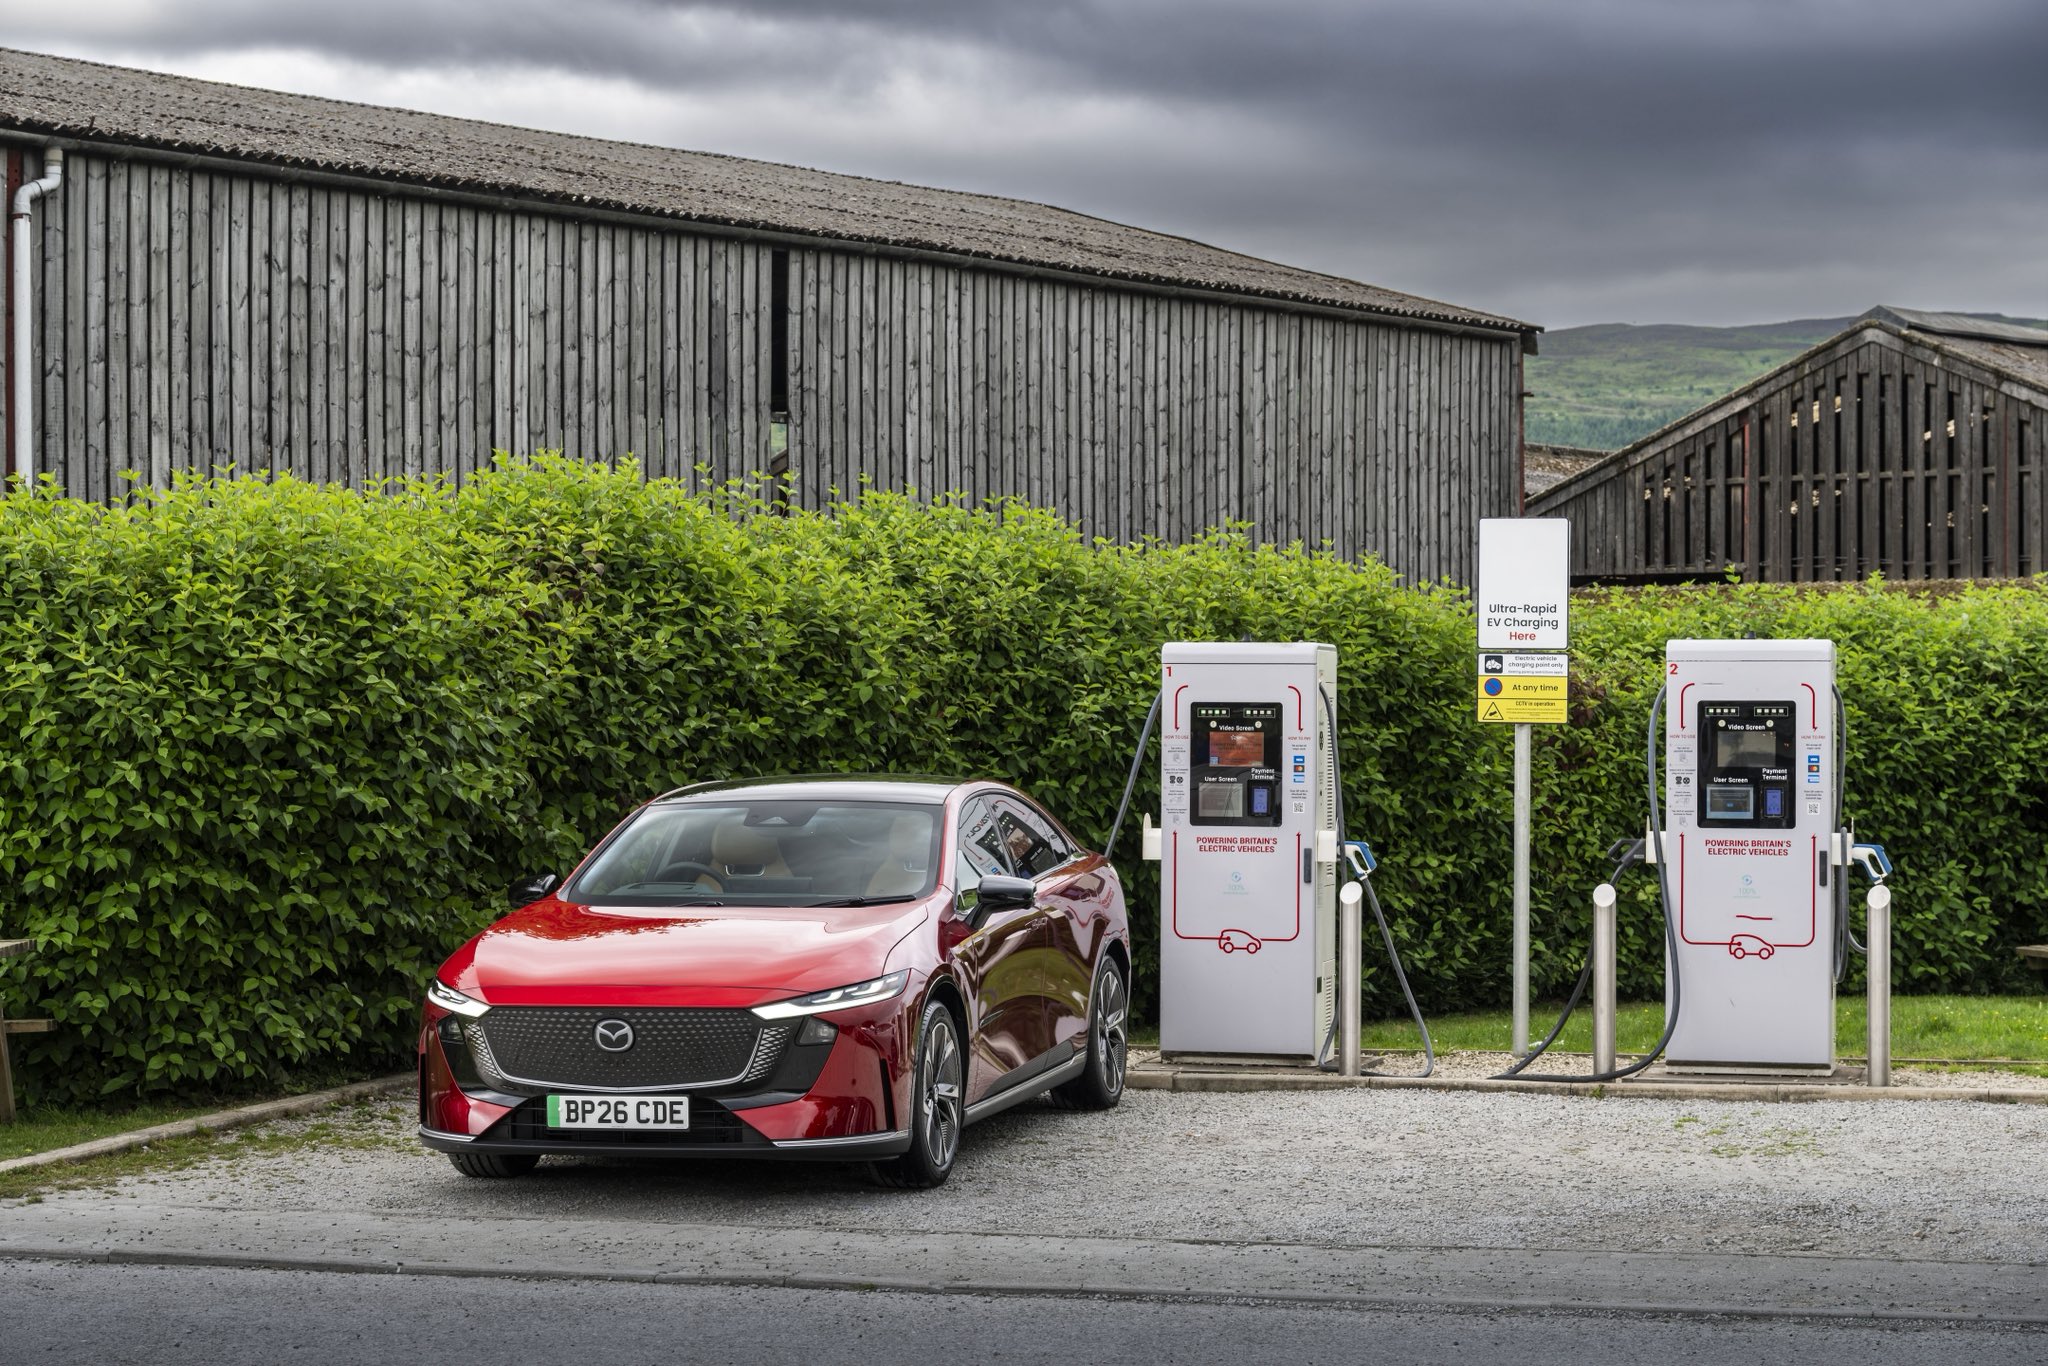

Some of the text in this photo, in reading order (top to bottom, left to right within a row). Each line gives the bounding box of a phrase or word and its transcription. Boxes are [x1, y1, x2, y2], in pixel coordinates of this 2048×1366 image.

[1489, 603, 1557, 616] Ultra-Rapid
[1487, 617, 1559, 630] EV Charging
[1509, 631, 1536, 641] Here
[1166, 666, 1172, 677] 1
[1669, 663, 1678, 675] 2
[1523, 685, 1538, 693] any
[1540, 684, 1559, 692] time
[1196, 836, 1278, 845] POWERING BRITAIN'S
[1705, 839, 1792, 848] POWERING BRITAIN'S
[1707, 848, 1789, 856] ELECTRIC VEHICLES
[565, 1099, 684, 1125] BP26 CDE
